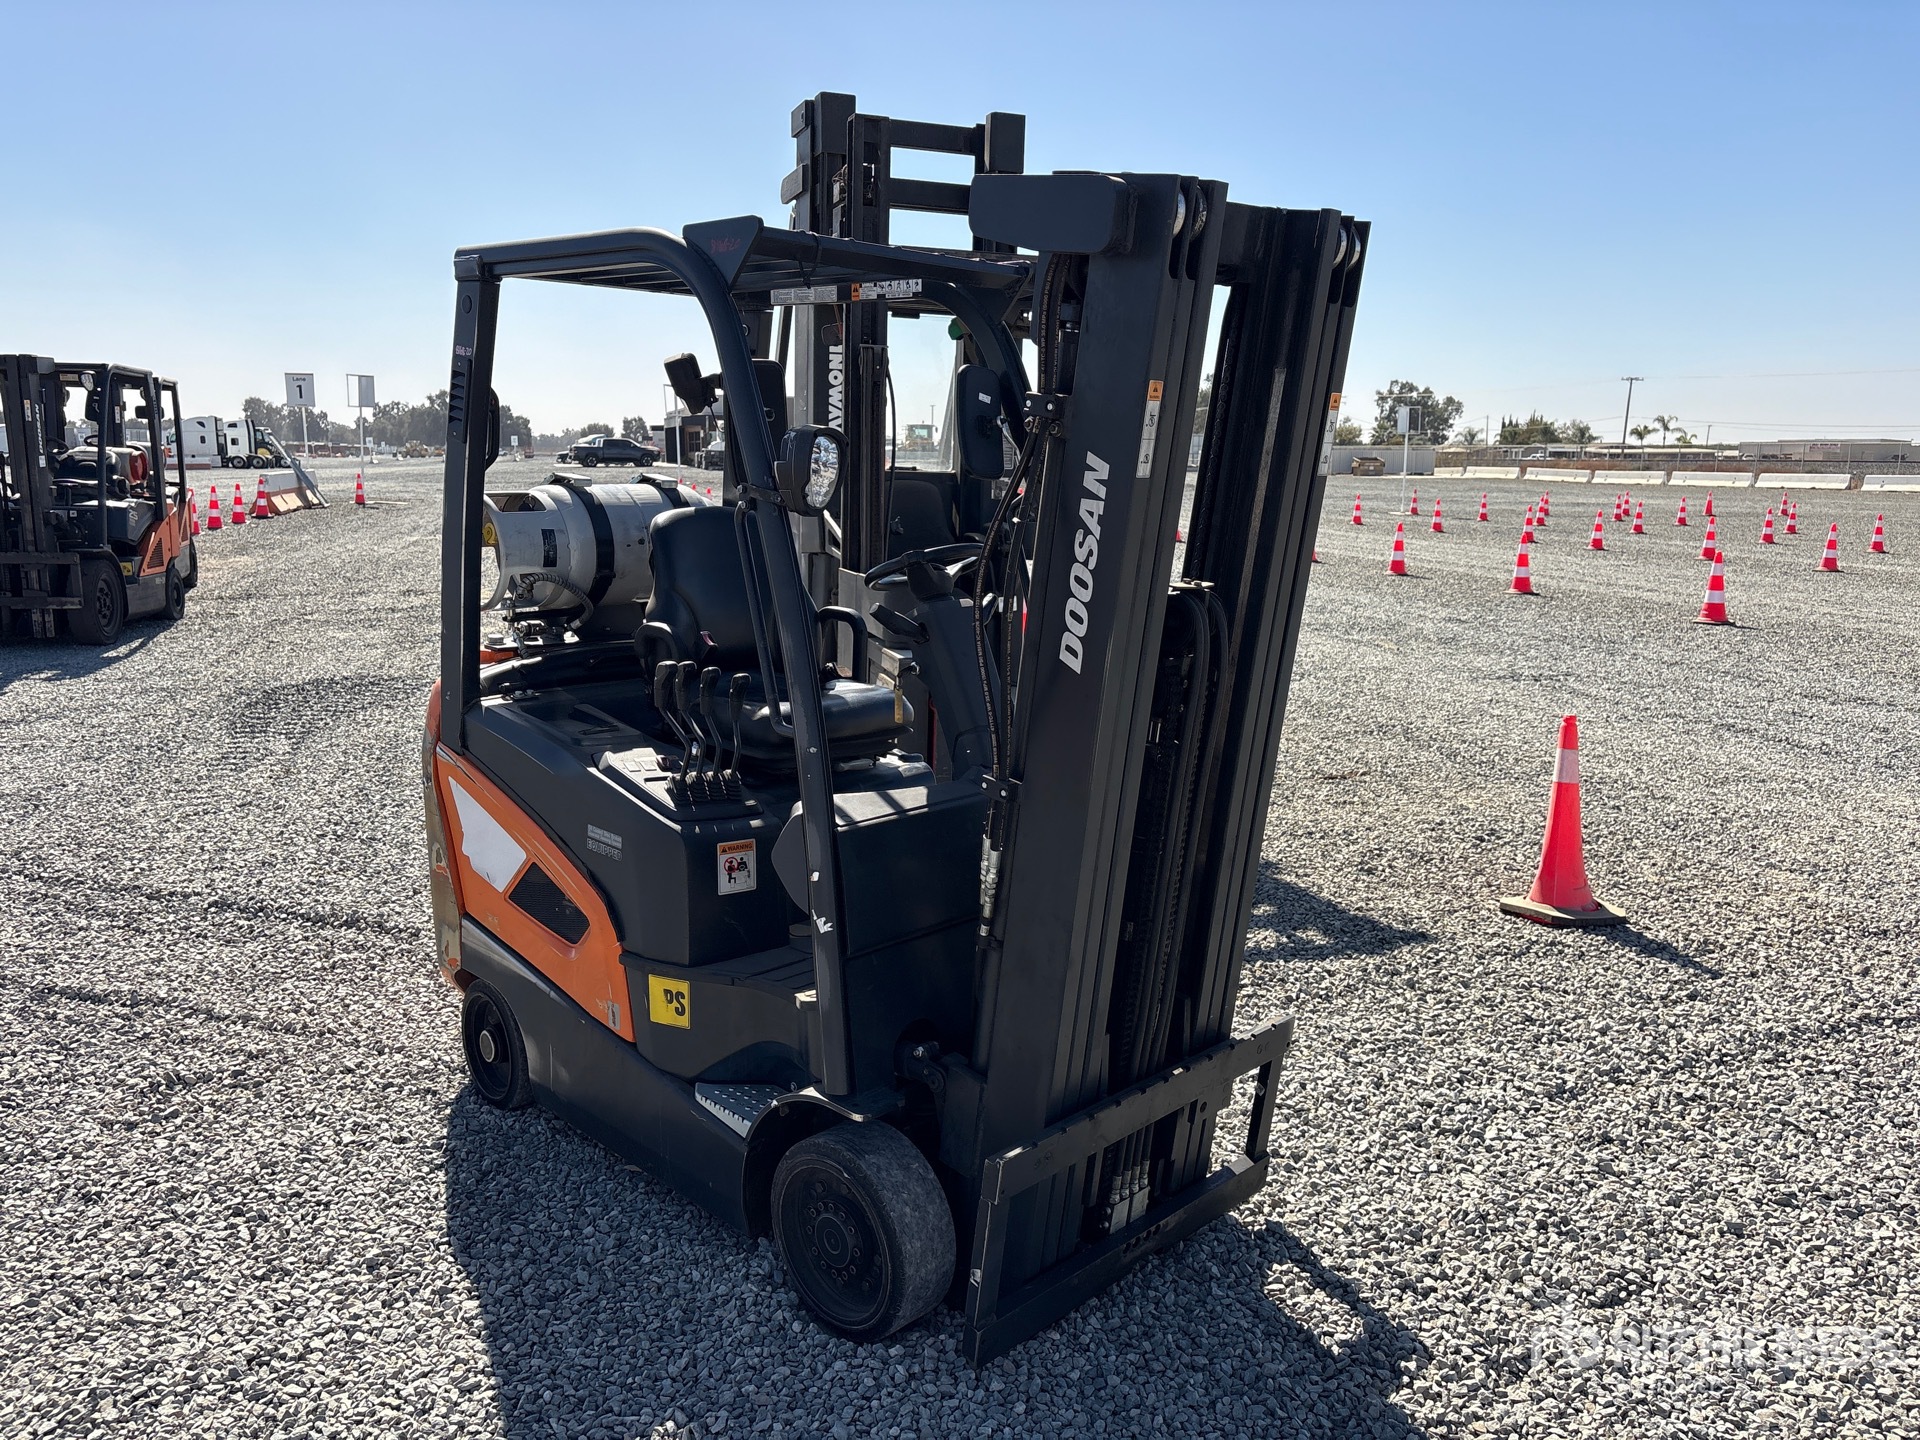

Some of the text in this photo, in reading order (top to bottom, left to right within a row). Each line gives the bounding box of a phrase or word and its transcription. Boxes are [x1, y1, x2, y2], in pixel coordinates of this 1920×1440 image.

[296, 385, 303, 399] 1
[828, 345, 843, 433] AYMON
[1059, 450, 1111, 674] DOOSAN
[586, 837, 623, 861] EQUIPPED
[727, 843, 753, 852] WARNING
